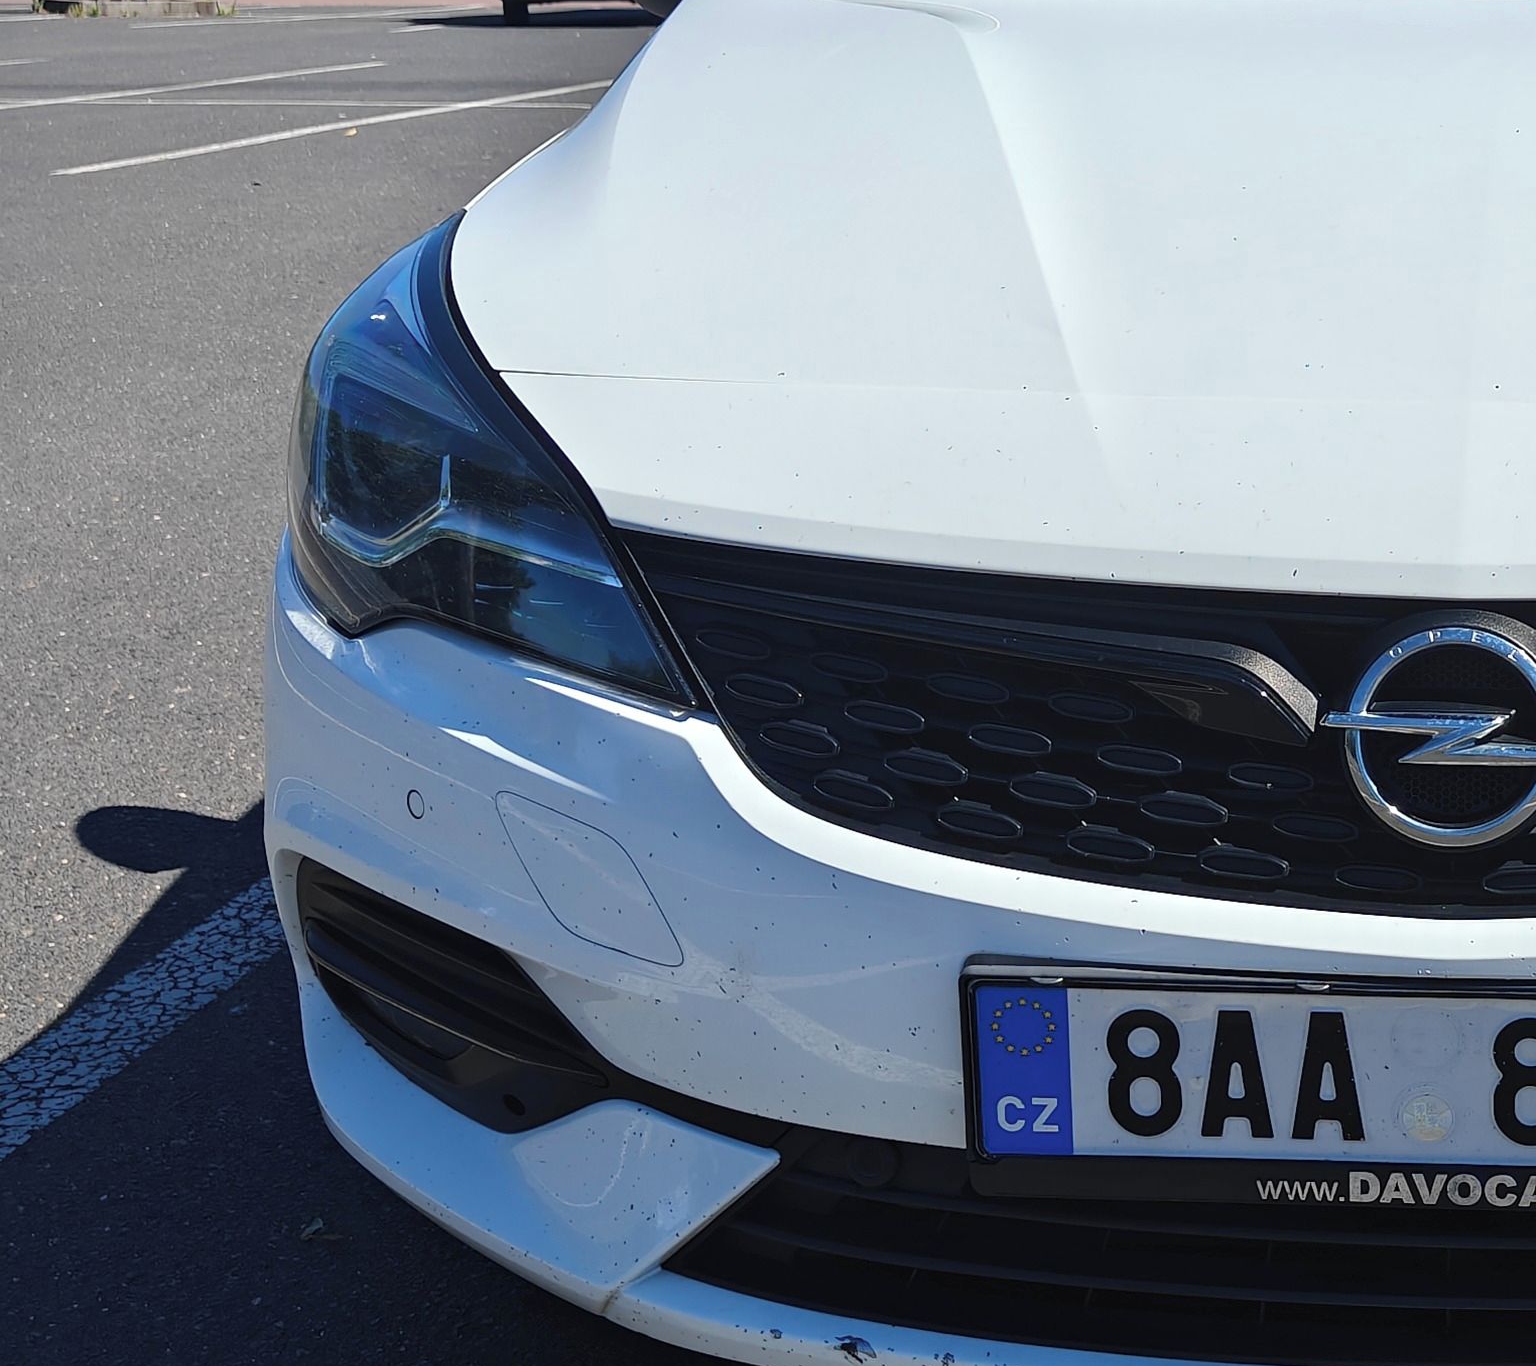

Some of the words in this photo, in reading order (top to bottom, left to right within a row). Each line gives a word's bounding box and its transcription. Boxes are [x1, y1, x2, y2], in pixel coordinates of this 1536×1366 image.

[1389, 629, 1519, 663] OPEL
[996, 1095, 1060, 1133] CZ
[1106, 1008, 1366, 1142] 8AA
